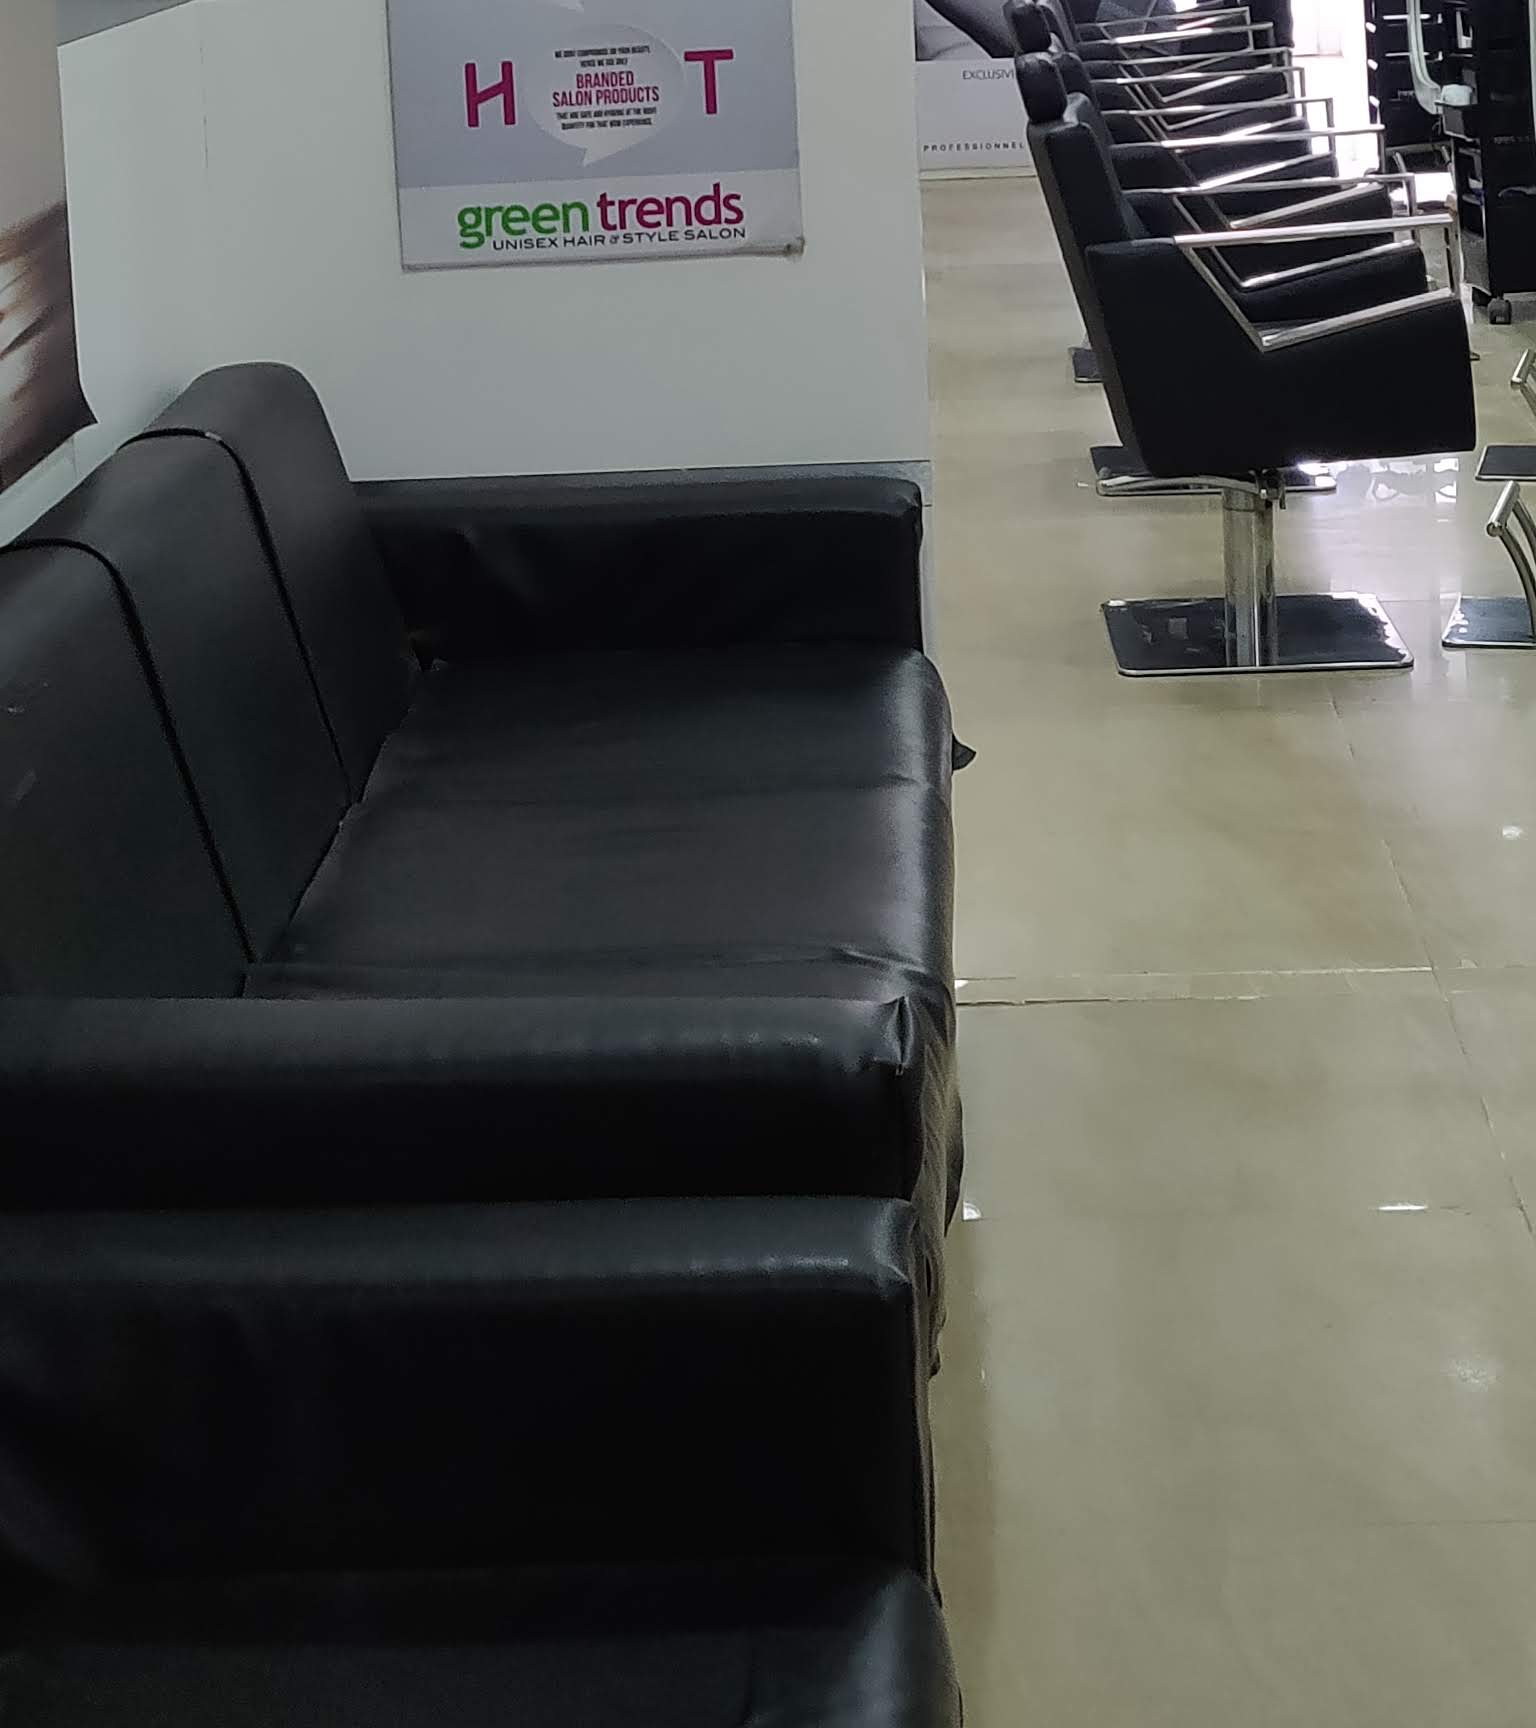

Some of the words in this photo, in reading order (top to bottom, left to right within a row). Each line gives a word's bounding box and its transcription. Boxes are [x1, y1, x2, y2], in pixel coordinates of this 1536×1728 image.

[576, 71, 634, 88] BRANDED
[684, 49, 734, 114] T
[962, 69, 1014, 80] EXCLUSIV
[464, 60, 516, 128] H
[552, 91, 592, 107] SALON
[596, 86, 659, 105] PRODUCTS
[922, 142, 1025, 152] PROFESSIONNEL
[457, 201, 589, 250] green
[596, 181, 744, 231] trends
[492, 237, 559, 250] UNISEX
[563, 234, 605, 248] HAIR
[622, 230, 679, 244] STYLE
[684, 227, 746, 241] SALON
